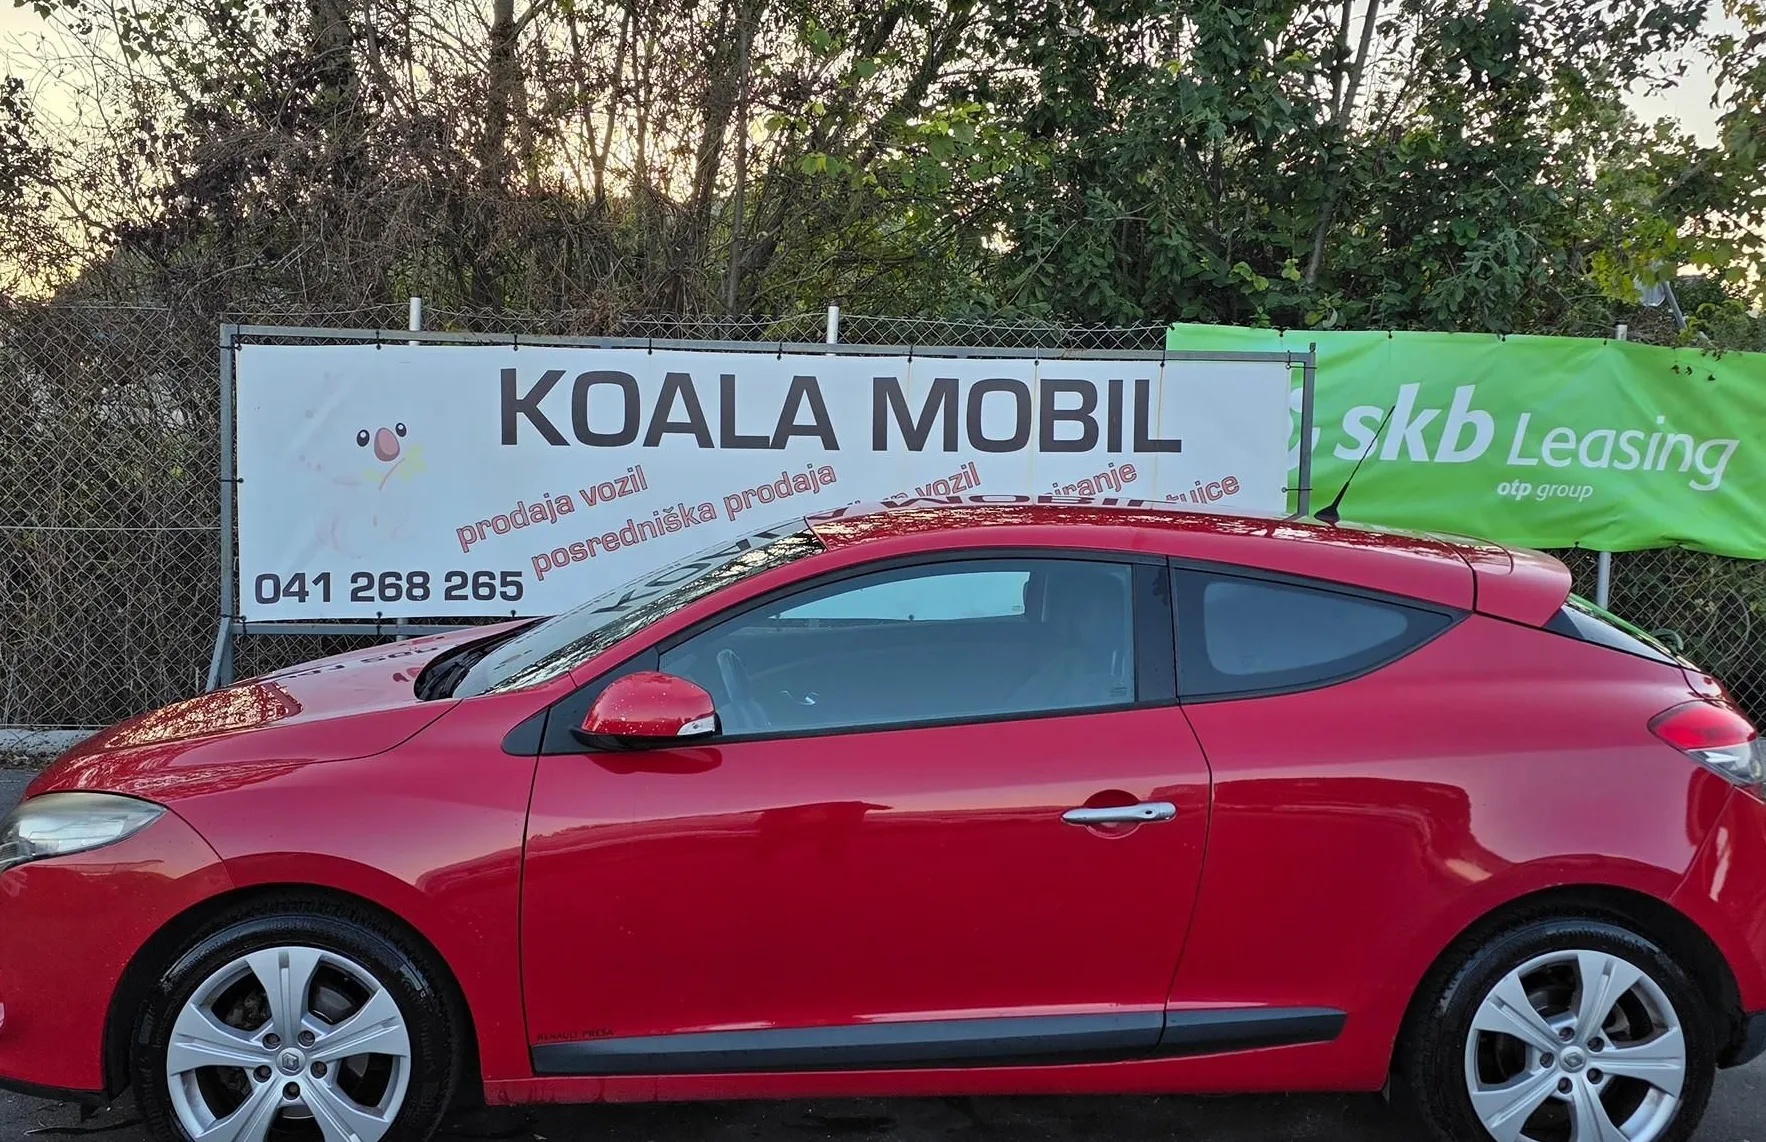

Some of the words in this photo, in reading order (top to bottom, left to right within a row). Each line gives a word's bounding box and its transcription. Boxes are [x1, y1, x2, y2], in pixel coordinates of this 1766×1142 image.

[501, 367, 840, 452] KOALA
[872, 376, 1182, 454] MOBIL
[1334, 382, 1495, 463] skb
[1506, 412, 1741, 492] Leasing
[456, 491, 574, 554] prodaja
[579, 464, 651, 508] vozil
[531, 499, 718, 582] posredniška
[723, 462, 837, 521] prodaja
[915, 461, 982, 498] vozil
[1496, 477, 1533, 499] otp
[1535, 482, 1594, 502] group
[254, 571, 332, 605] 041
[350, 570, 431, 603] 268
[444, 570, 525, 602] 265
